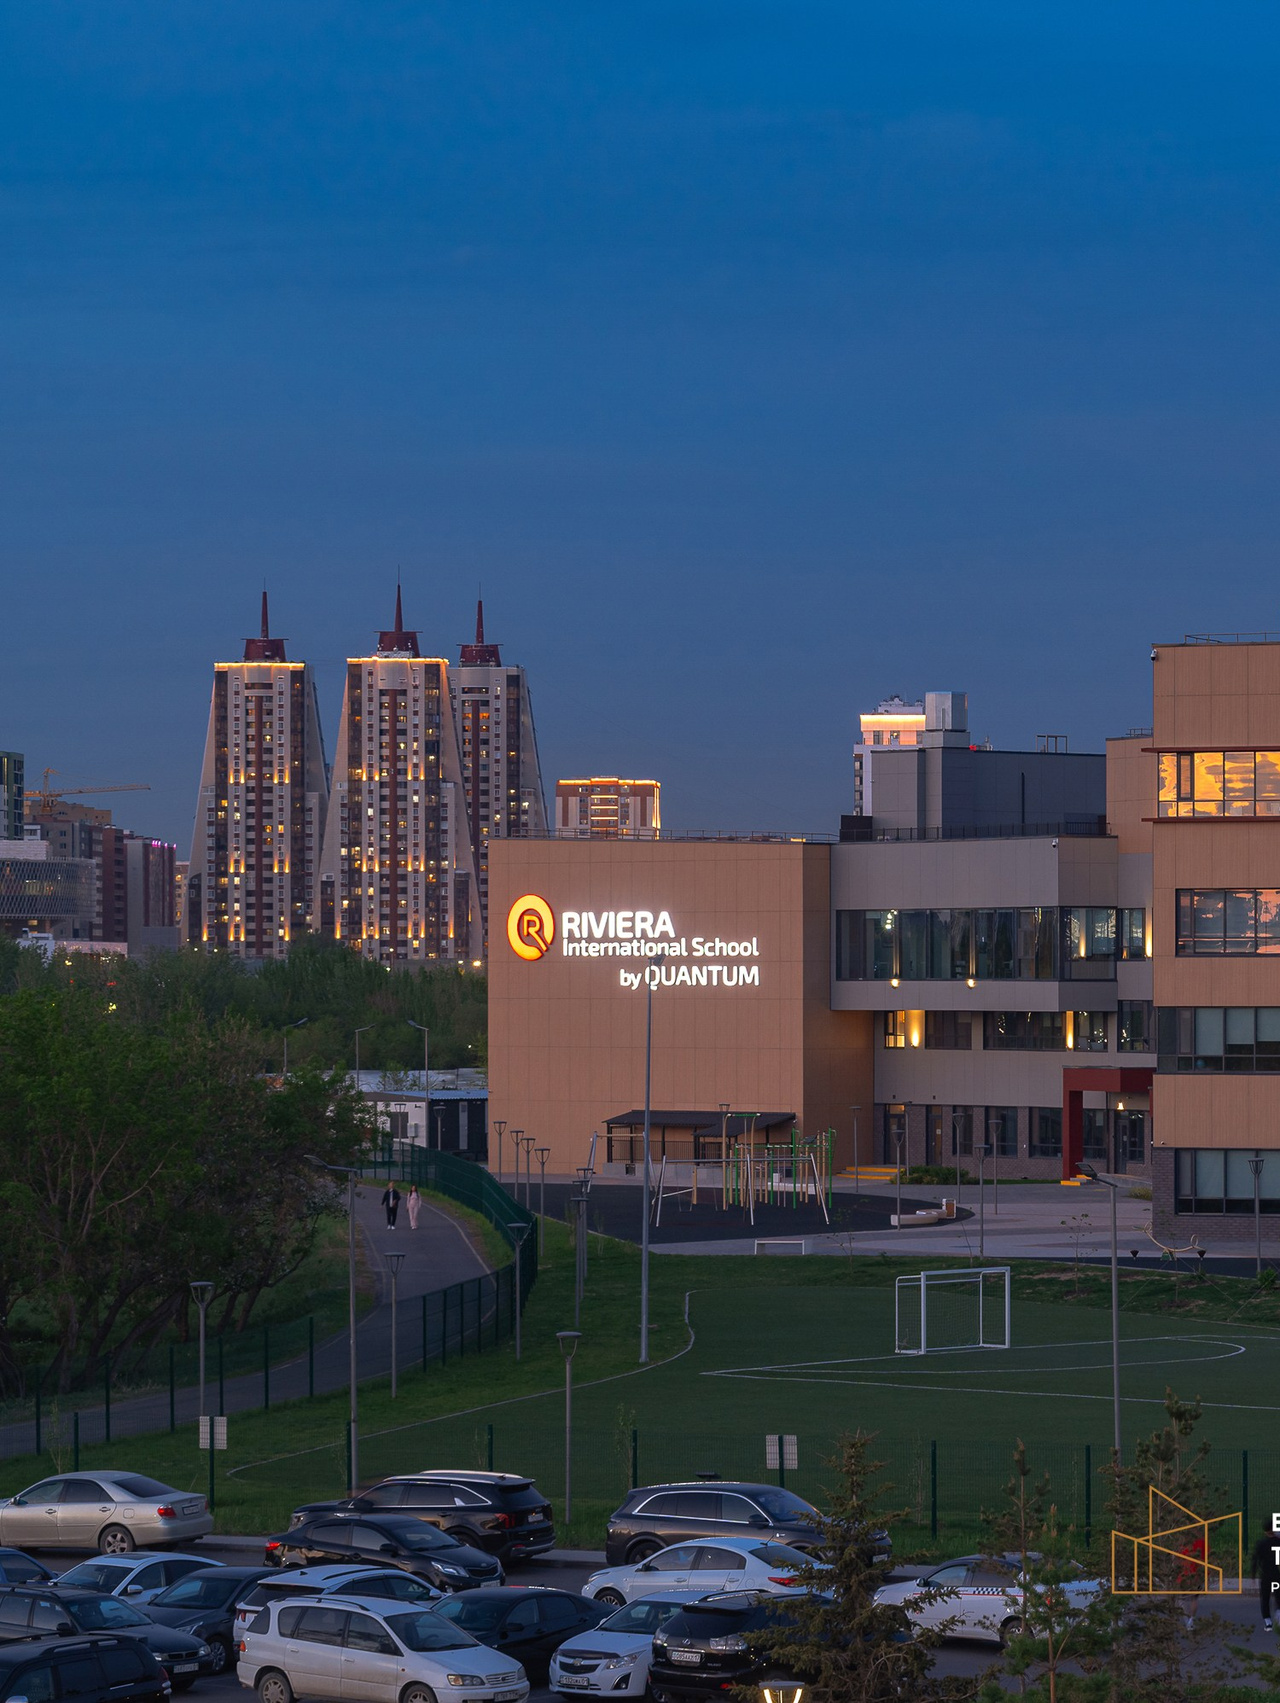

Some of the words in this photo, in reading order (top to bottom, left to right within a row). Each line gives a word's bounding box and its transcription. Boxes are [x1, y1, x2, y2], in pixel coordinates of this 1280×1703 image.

[562, 911, 676, 938] RIVIERA
[562, 938, 688, 957] International
[691, 937, 760, 957] School
[619, 968, 642, 990] by
[644, 965, 760, 990] QUANTUM
